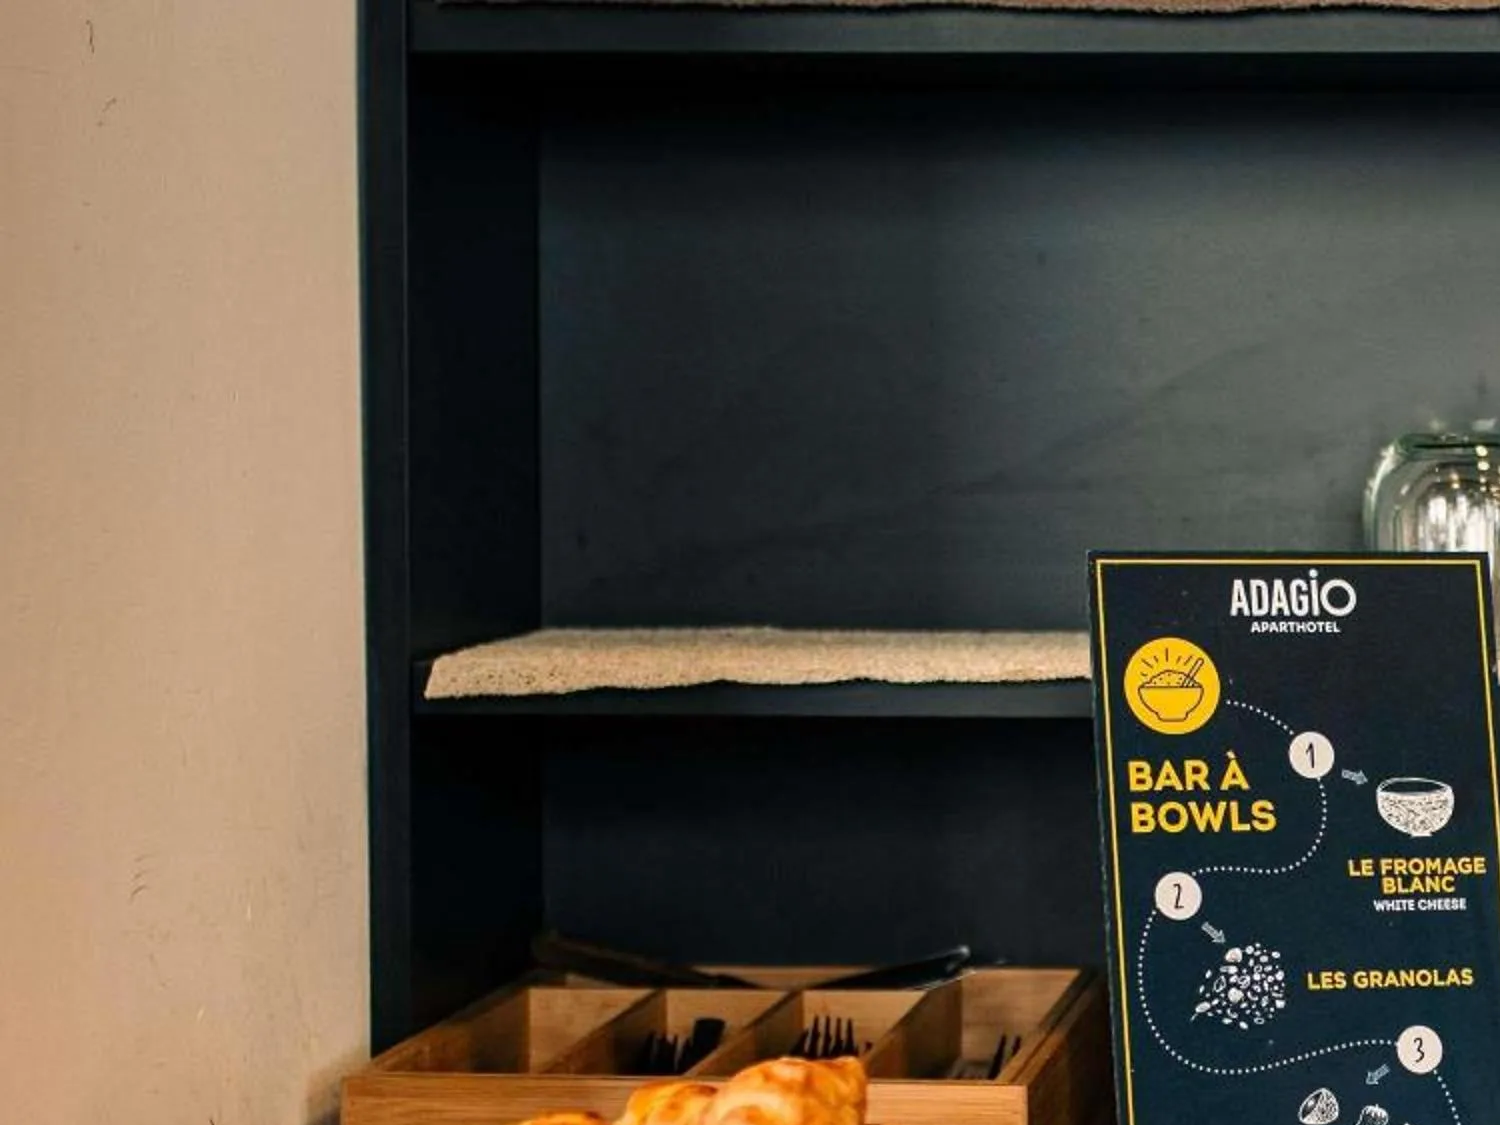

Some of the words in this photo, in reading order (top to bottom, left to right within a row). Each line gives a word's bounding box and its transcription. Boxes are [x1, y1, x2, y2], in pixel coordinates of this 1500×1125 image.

[1251, 621, 1341, 633] APARTHOTEL
[1305, 742, 1315, 769] 1
[1128, 759, 1210, 792] BAR
[1220, 750, 1250, 791] À
[1131, 800, 1277, 833] BOWLS
[1348, 859, 1375, 877] LE
[1380, 857, 1487, 876] FROMAGE
[1173, 883, 1184, 909] 2
[1382, 876, 1455, 894] BLANC
[1373, 899, 1415, 912] WHITE
[1417, 898, 1467, 911] CHEESE
[1307, 971, 1347, 990] LES
[1353, 968, 1474, 989] GRANOLAS
[1413, 1037, 1425, 1063] 3
